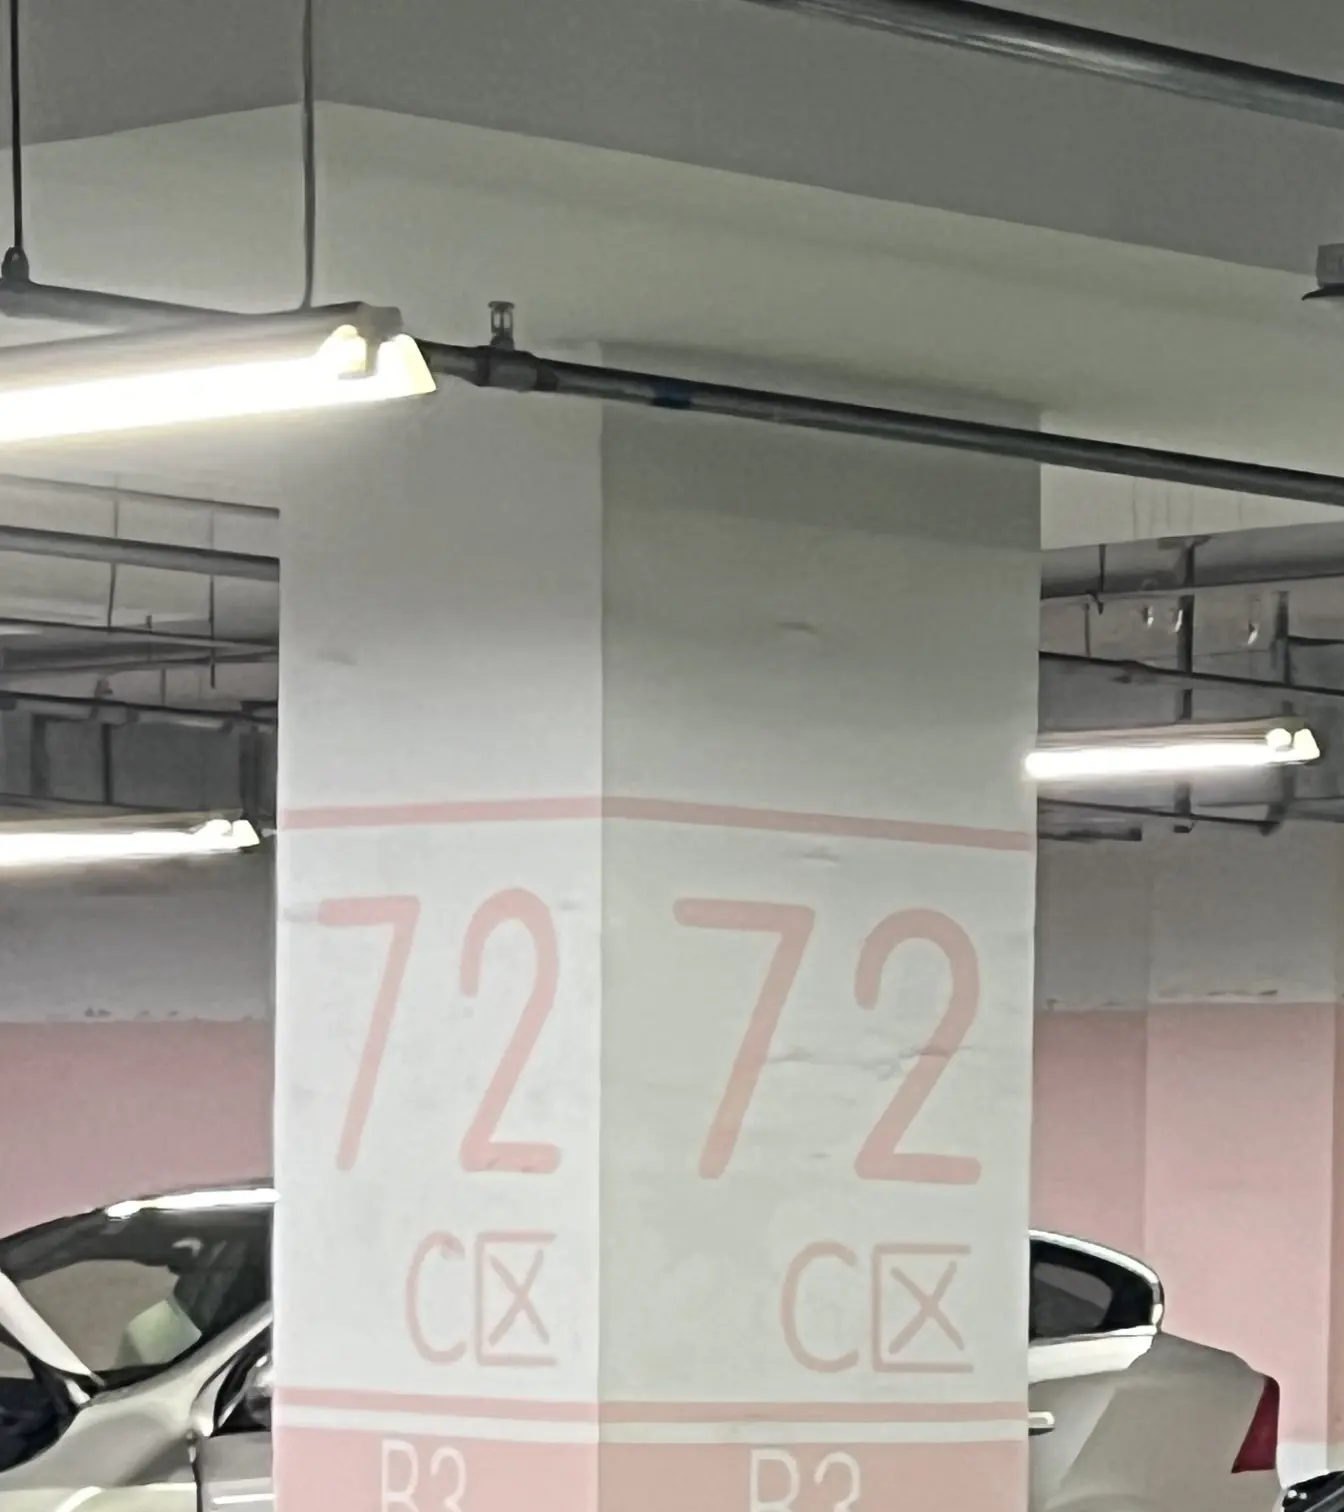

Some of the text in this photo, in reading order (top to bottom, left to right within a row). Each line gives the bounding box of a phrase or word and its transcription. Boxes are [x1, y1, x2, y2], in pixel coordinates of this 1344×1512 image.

[317, 888, 561, 1175] 72
[672, 897, 981, 1185] 72
[406, 1231, 558, 1366] C区
[780, 1241, 974, 1373] C区
